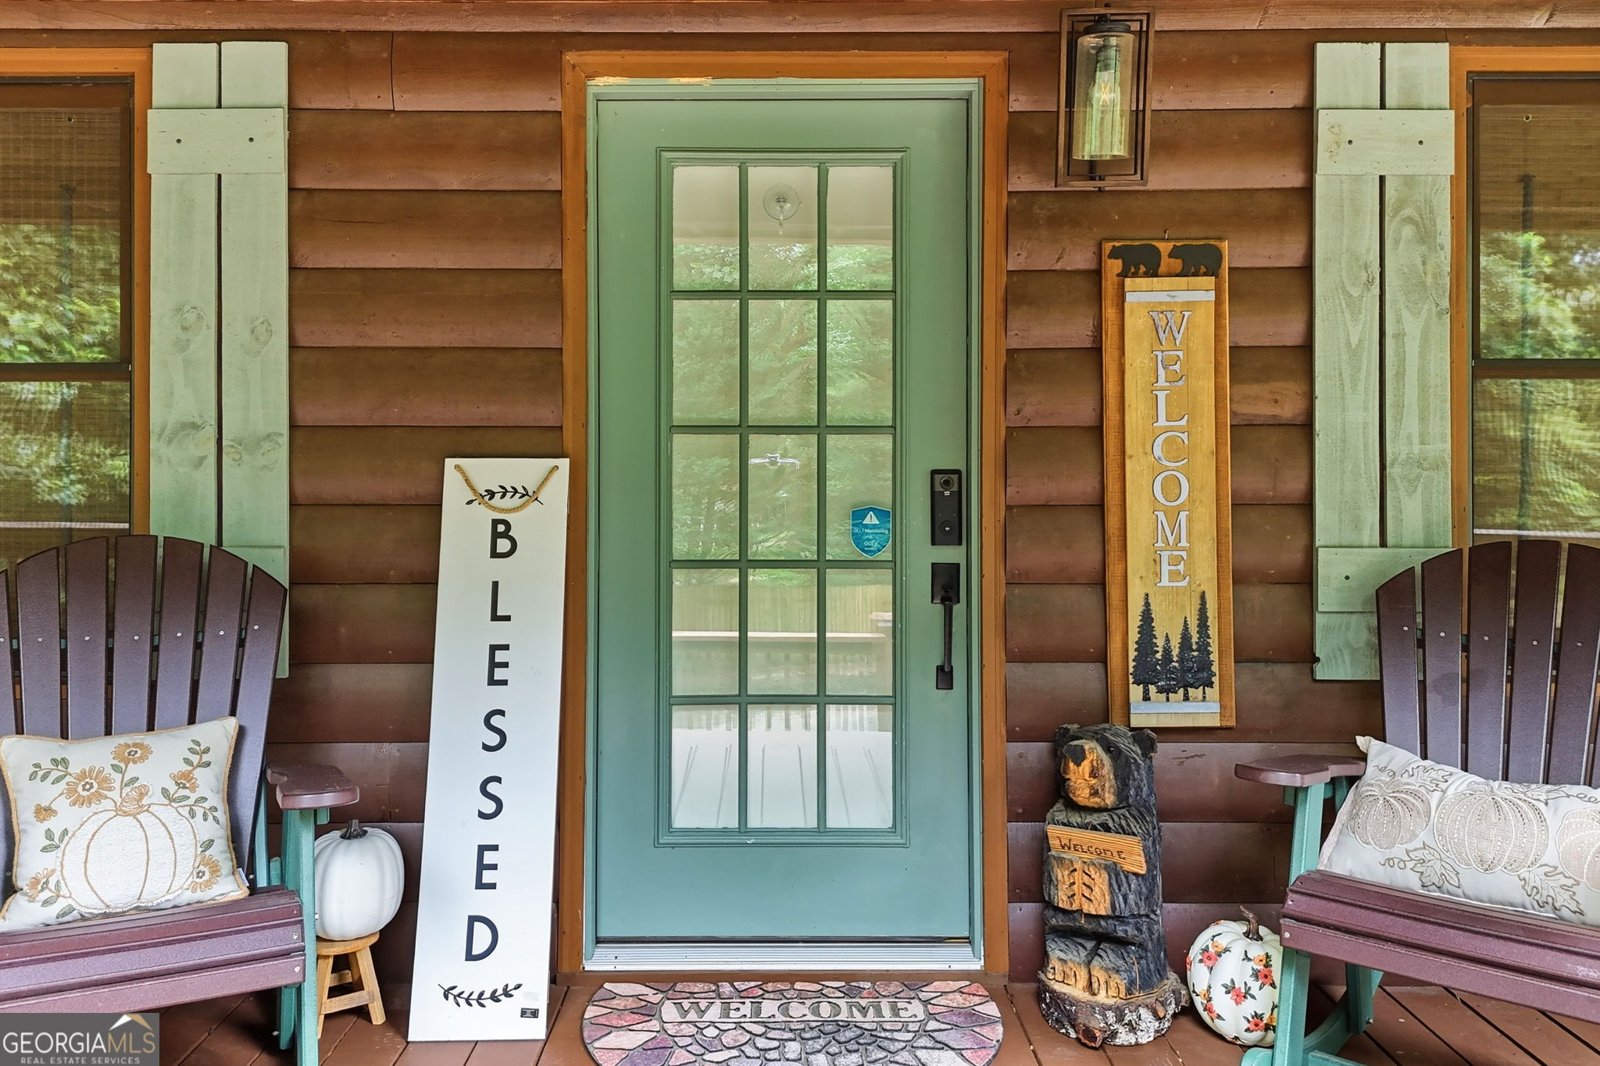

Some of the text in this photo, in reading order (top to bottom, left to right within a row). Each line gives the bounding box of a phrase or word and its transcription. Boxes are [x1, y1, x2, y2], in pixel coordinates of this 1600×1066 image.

[1148, 310, 1192, 587] WELCOME
[464, 519, 518, 962] BLESSED
[673, 1001, 918, 1020] WELCOME
